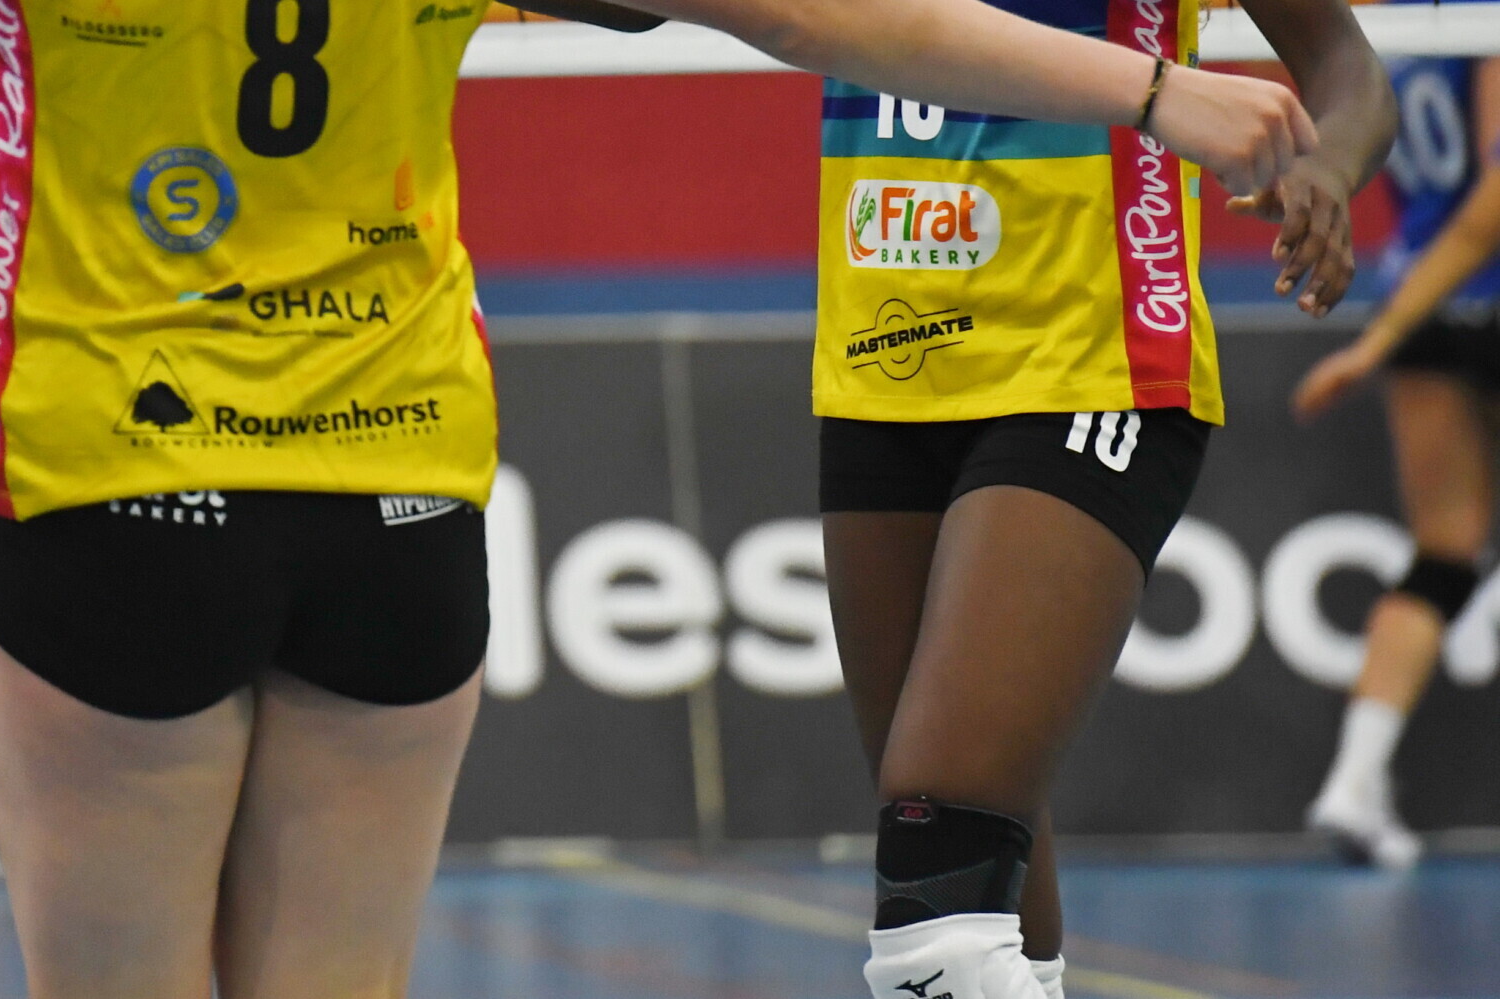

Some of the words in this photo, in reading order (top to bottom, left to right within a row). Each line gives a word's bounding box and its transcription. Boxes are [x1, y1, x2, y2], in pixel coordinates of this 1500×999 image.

[880, 186, 979, 243] Firat
[1124, 128, 1189, 334] GirlPowe
[881, 248, 980, 266] BAKERY
[249, 289, 390, 325] GHALA
[845, 314, 975, 359] MASTERMATE
[213, 398, 442, 437] Rouwenhorst
[1064, 410, 1143, 473] 10
